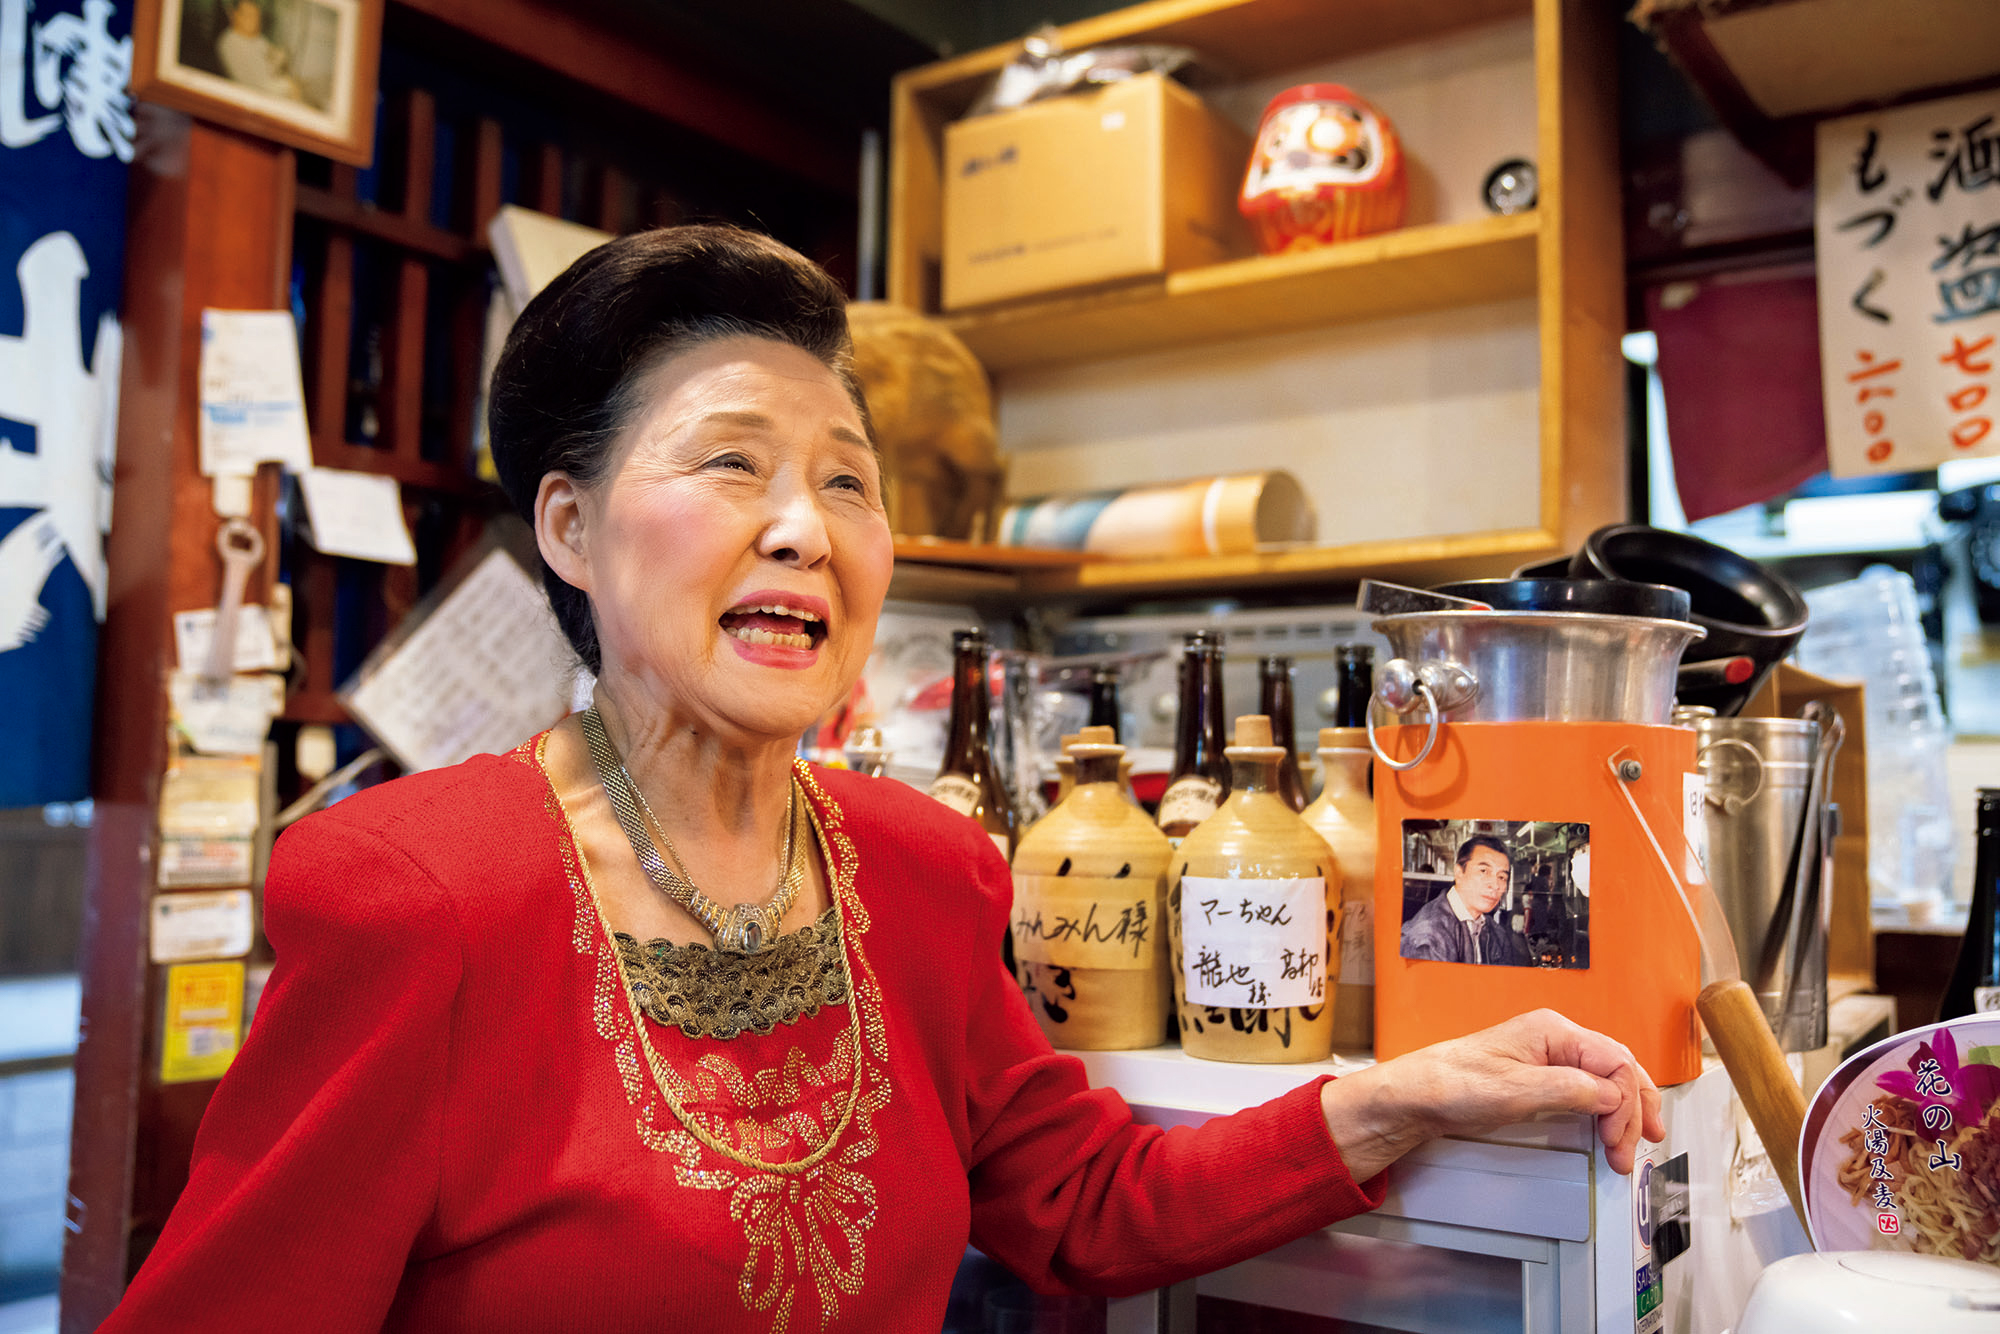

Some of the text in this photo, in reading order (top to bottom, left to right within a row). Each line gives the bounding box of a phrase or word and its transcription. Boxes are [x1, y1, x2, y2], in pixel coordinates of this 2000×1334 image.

[1837, 128, 1913, 324] もづく
[1915, 1059, 1962, 1172] 花の山
[1640, 1285, 1661, 1313] CARD
